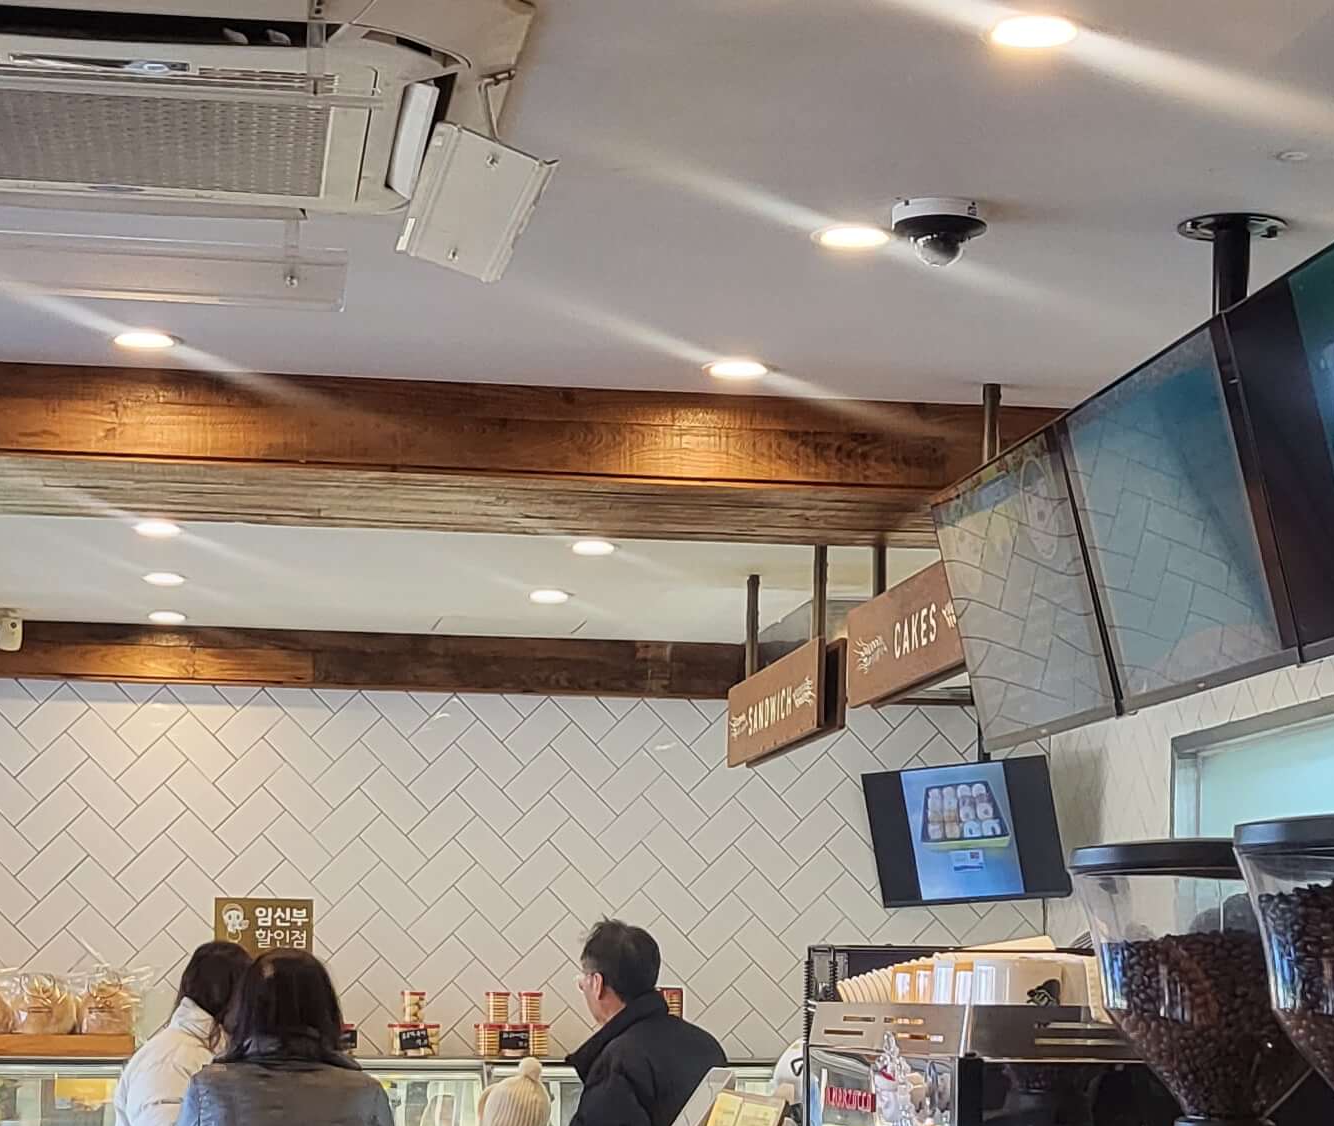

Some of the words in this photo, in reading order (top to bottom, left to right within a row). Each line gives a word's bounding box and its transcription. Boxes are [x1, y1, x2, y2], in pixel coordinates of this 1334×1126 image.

[892, 602, 937, 659] CAKES
[747, 686, 793, 736] SANDWICH
[254, 907, 309, 927] 임신부
[255, 928, 307, 949] 할인점
